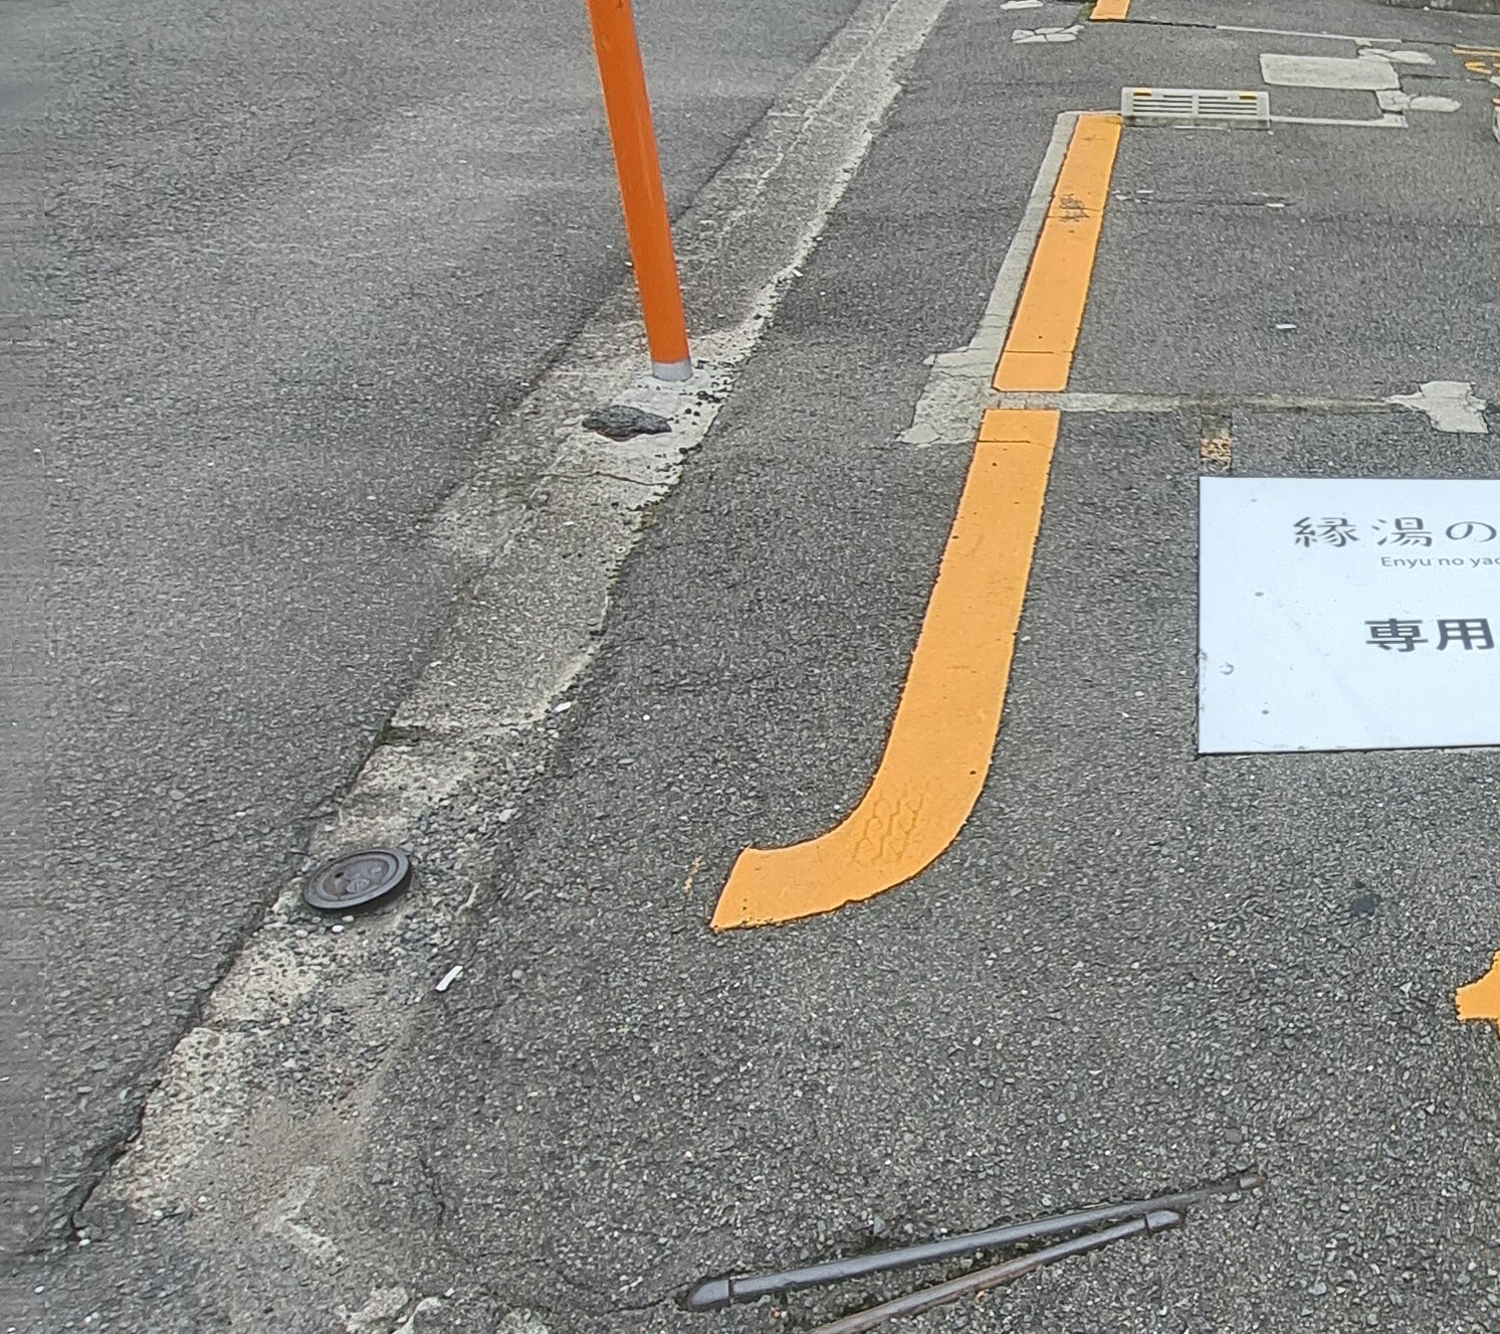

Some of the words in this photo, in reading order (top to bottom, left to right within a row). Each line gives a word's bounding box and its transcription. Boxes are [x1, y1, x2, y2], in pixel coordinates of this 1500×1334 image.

[1381, 556, 1432, 568] Enyu
[1437, 557, 1465, 567] no
[1364, 617, 1496, 653] 専用
